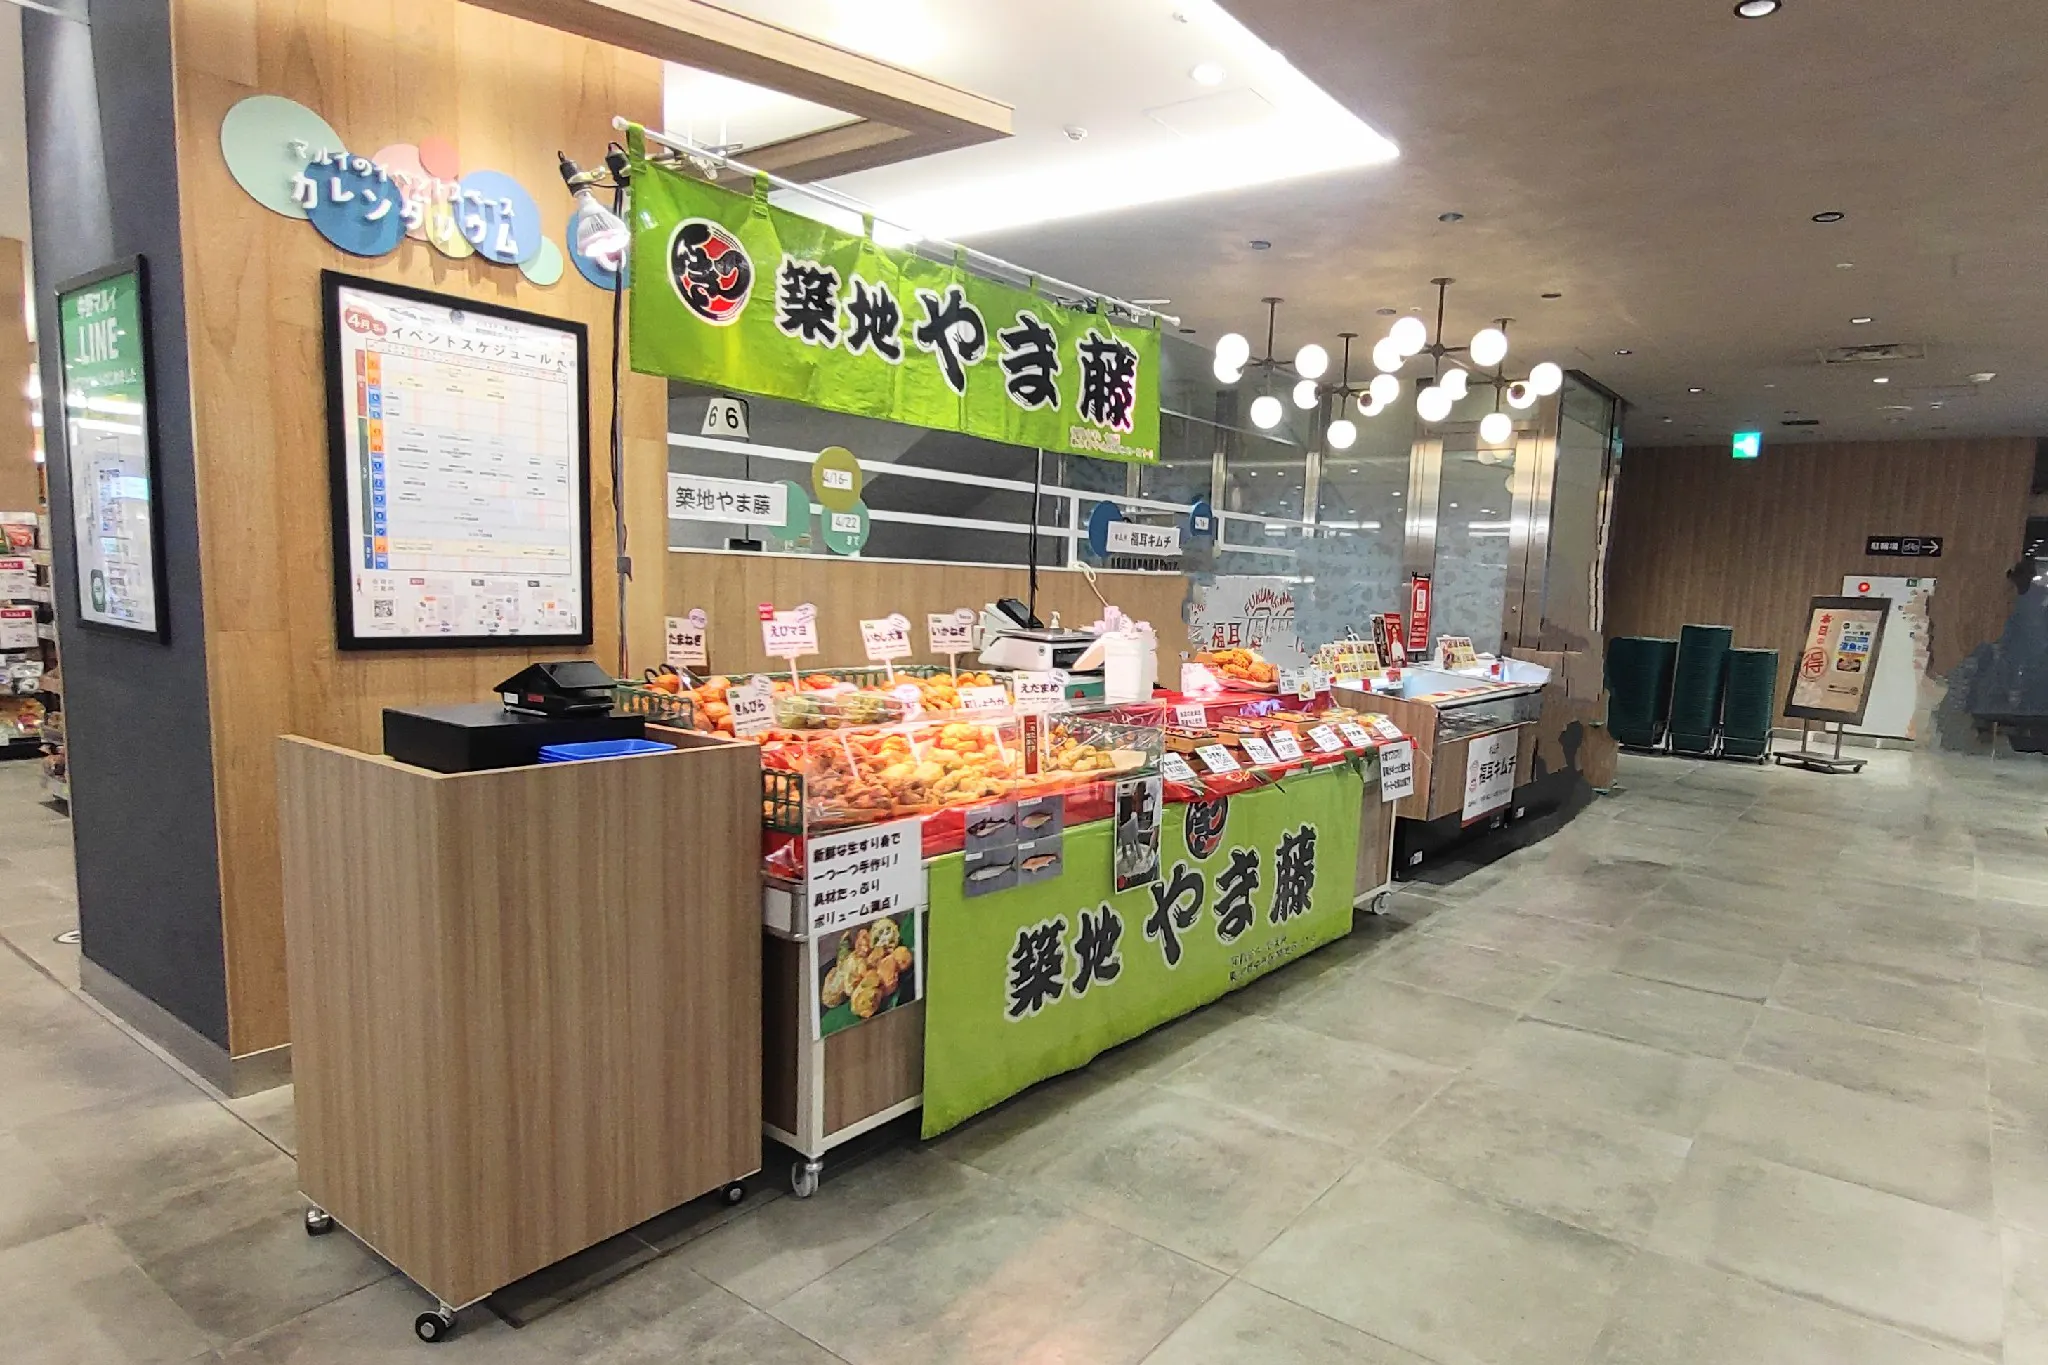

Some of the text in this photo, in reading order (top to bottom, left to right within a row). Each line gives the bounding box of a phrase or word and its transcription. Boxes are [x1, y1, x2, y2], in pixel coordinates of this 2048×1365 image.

[290, 170, 519, 256] カレンダリウム
[347, 313, 371, 331] 4月
[79, 317, 118, 365] LINE
[392, 326, 552, 365] イベントスケジュール
[776, 258, 1138, 432] 築地やま藤
[675, 486, 770, 515] 築地やま藤
[1130, 531, 1172, 548] 福耳キムチ
[668, 633, 702, 647] たまねぎ
[770, 624, 807, 638] えびマヨ
[1020, 683, 1060, 694] えだまめ
[813, 832, 901, 863] 新鮮な生すり身で
[814, 878, 880, 908] 具材たっぷり
[1008, 825, 1317, 1017] 築地やま藤
